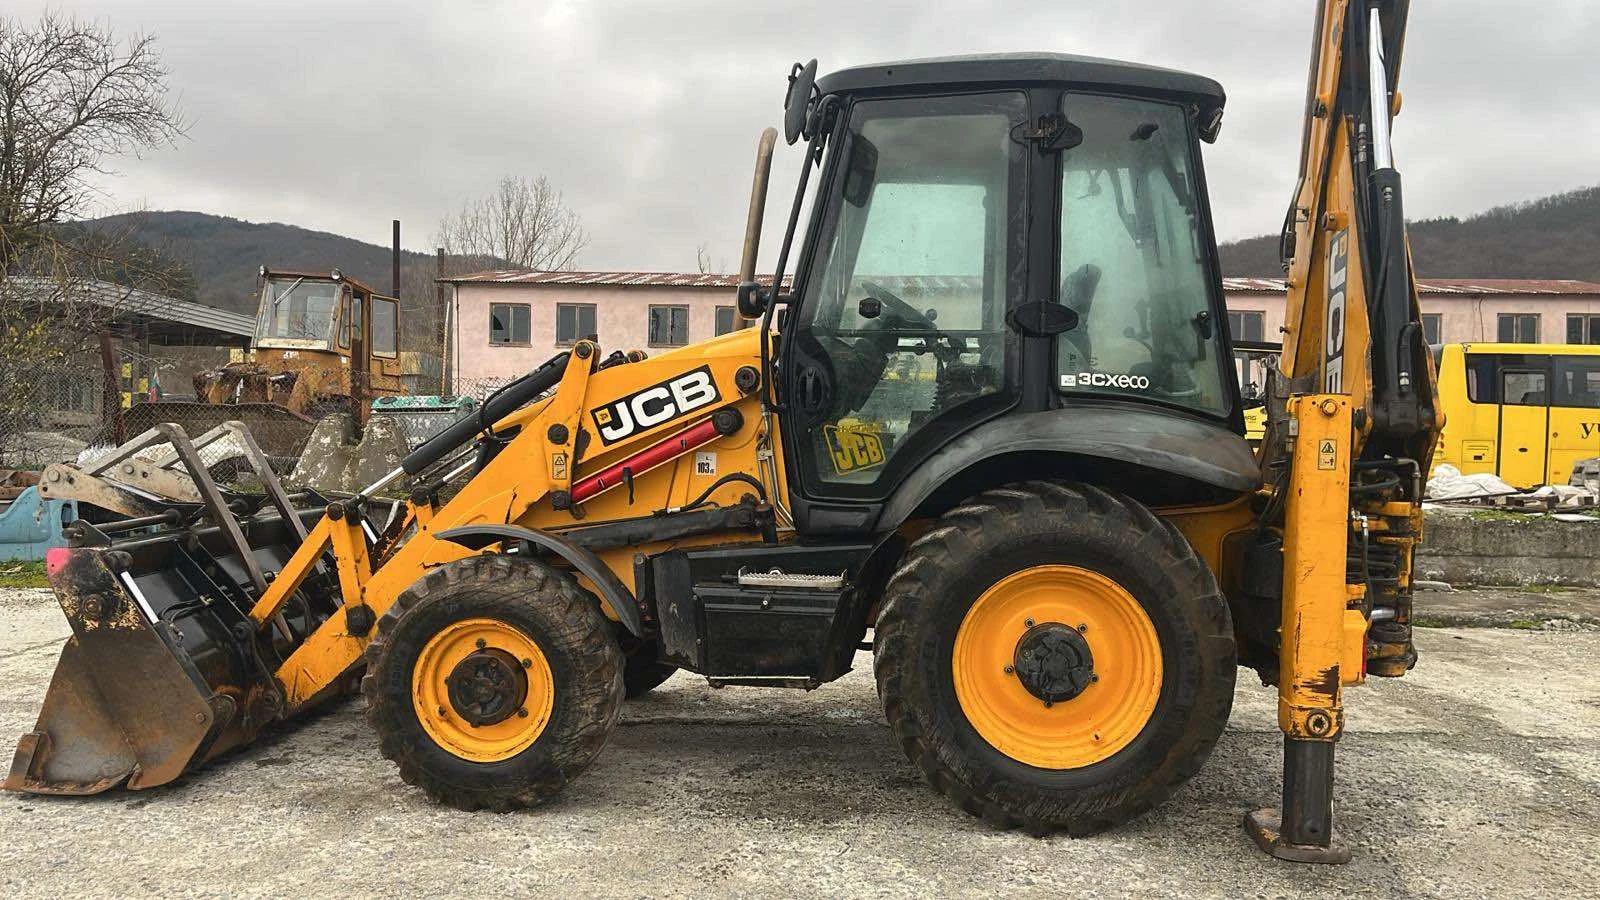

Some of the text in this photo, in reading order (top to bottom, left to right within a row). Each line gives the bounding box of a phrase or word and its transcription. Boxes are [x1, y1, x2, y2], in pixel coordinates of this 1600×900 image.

[601, 371, 716, 440] JCB
[697, 462, 710, 474] 103
[834, 431, 881, 470] JCB
